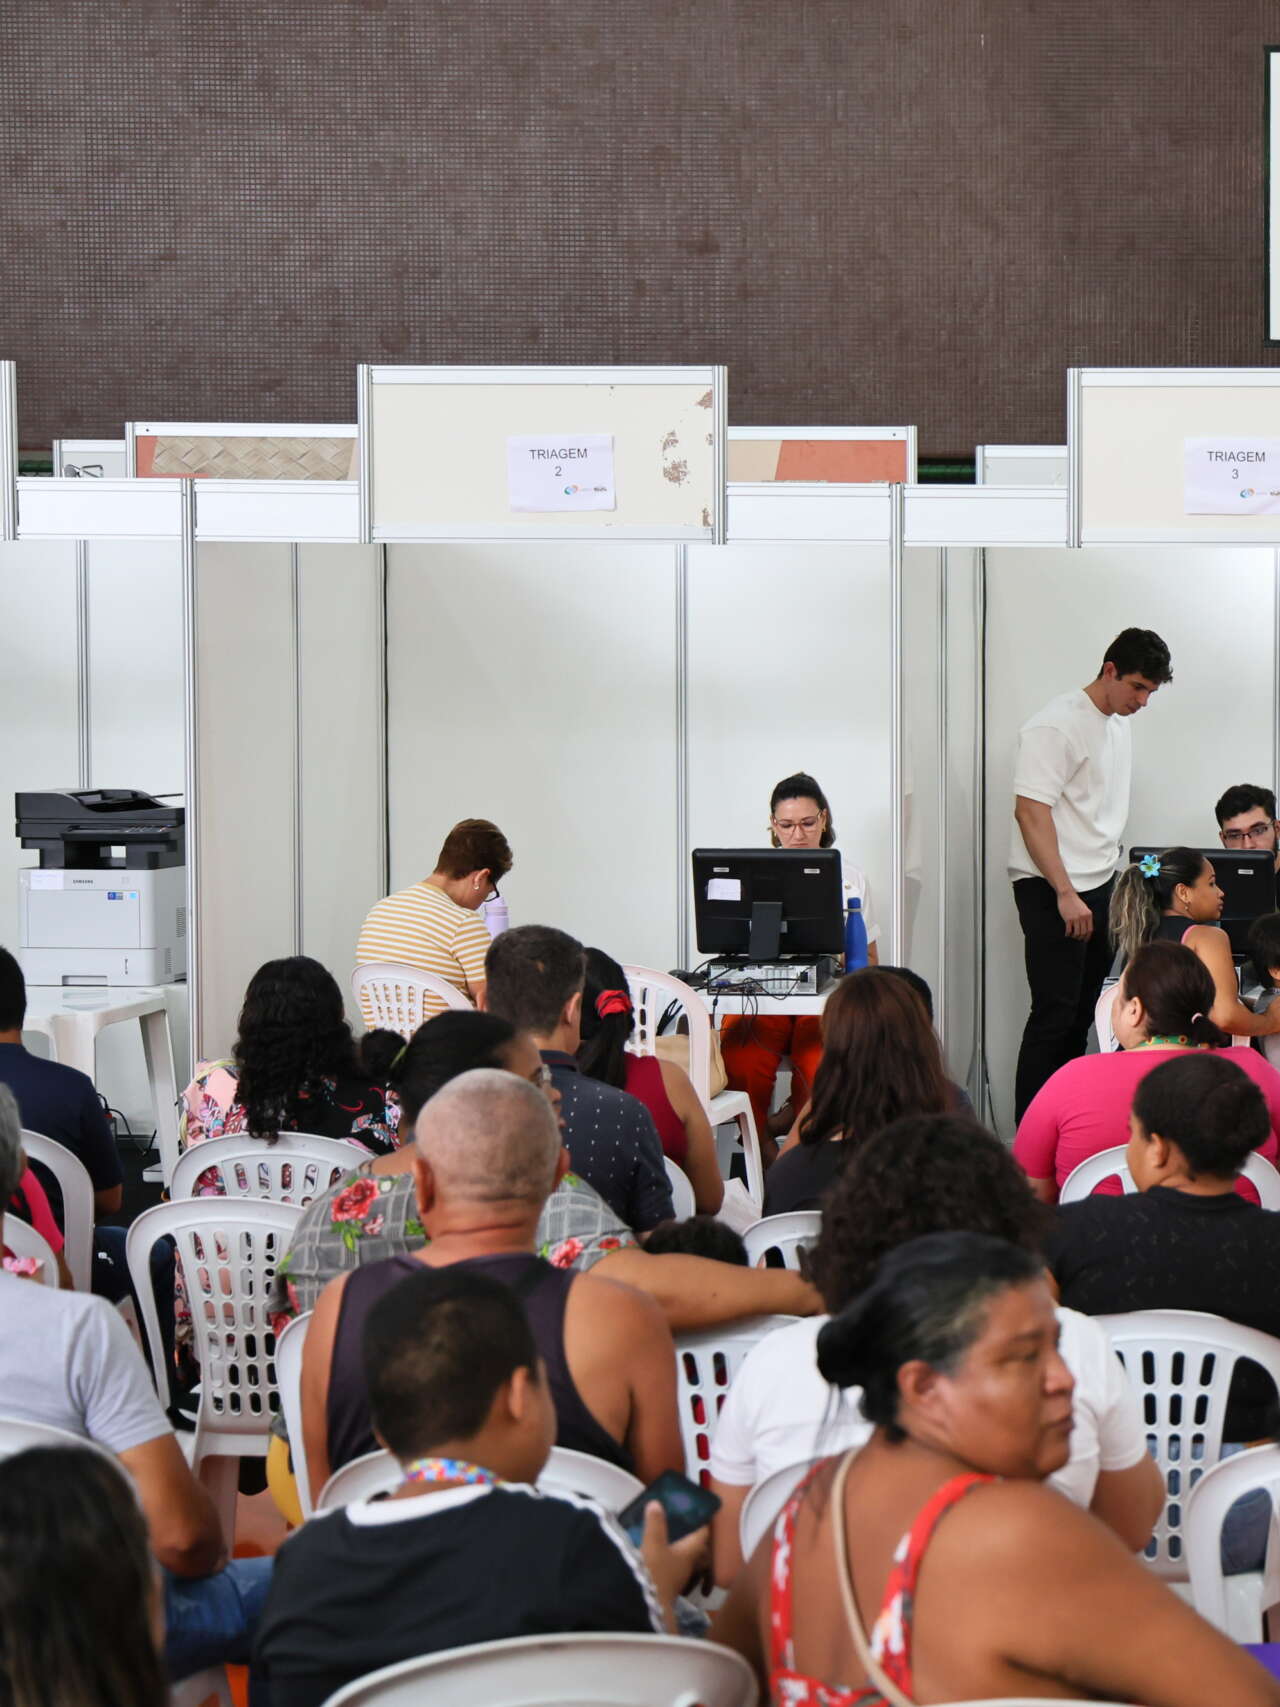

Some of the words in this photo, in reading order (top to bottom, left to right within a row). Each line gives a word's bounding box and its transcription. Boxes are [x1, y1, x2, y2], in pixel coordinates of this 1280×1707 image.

[528, 448, 588, 460] TRIAGEM
[1207, 451, 1266, 462] TRIAGEM
[554, 465, 563, 477] 2
[1231, 468, 1240, 480] 3
